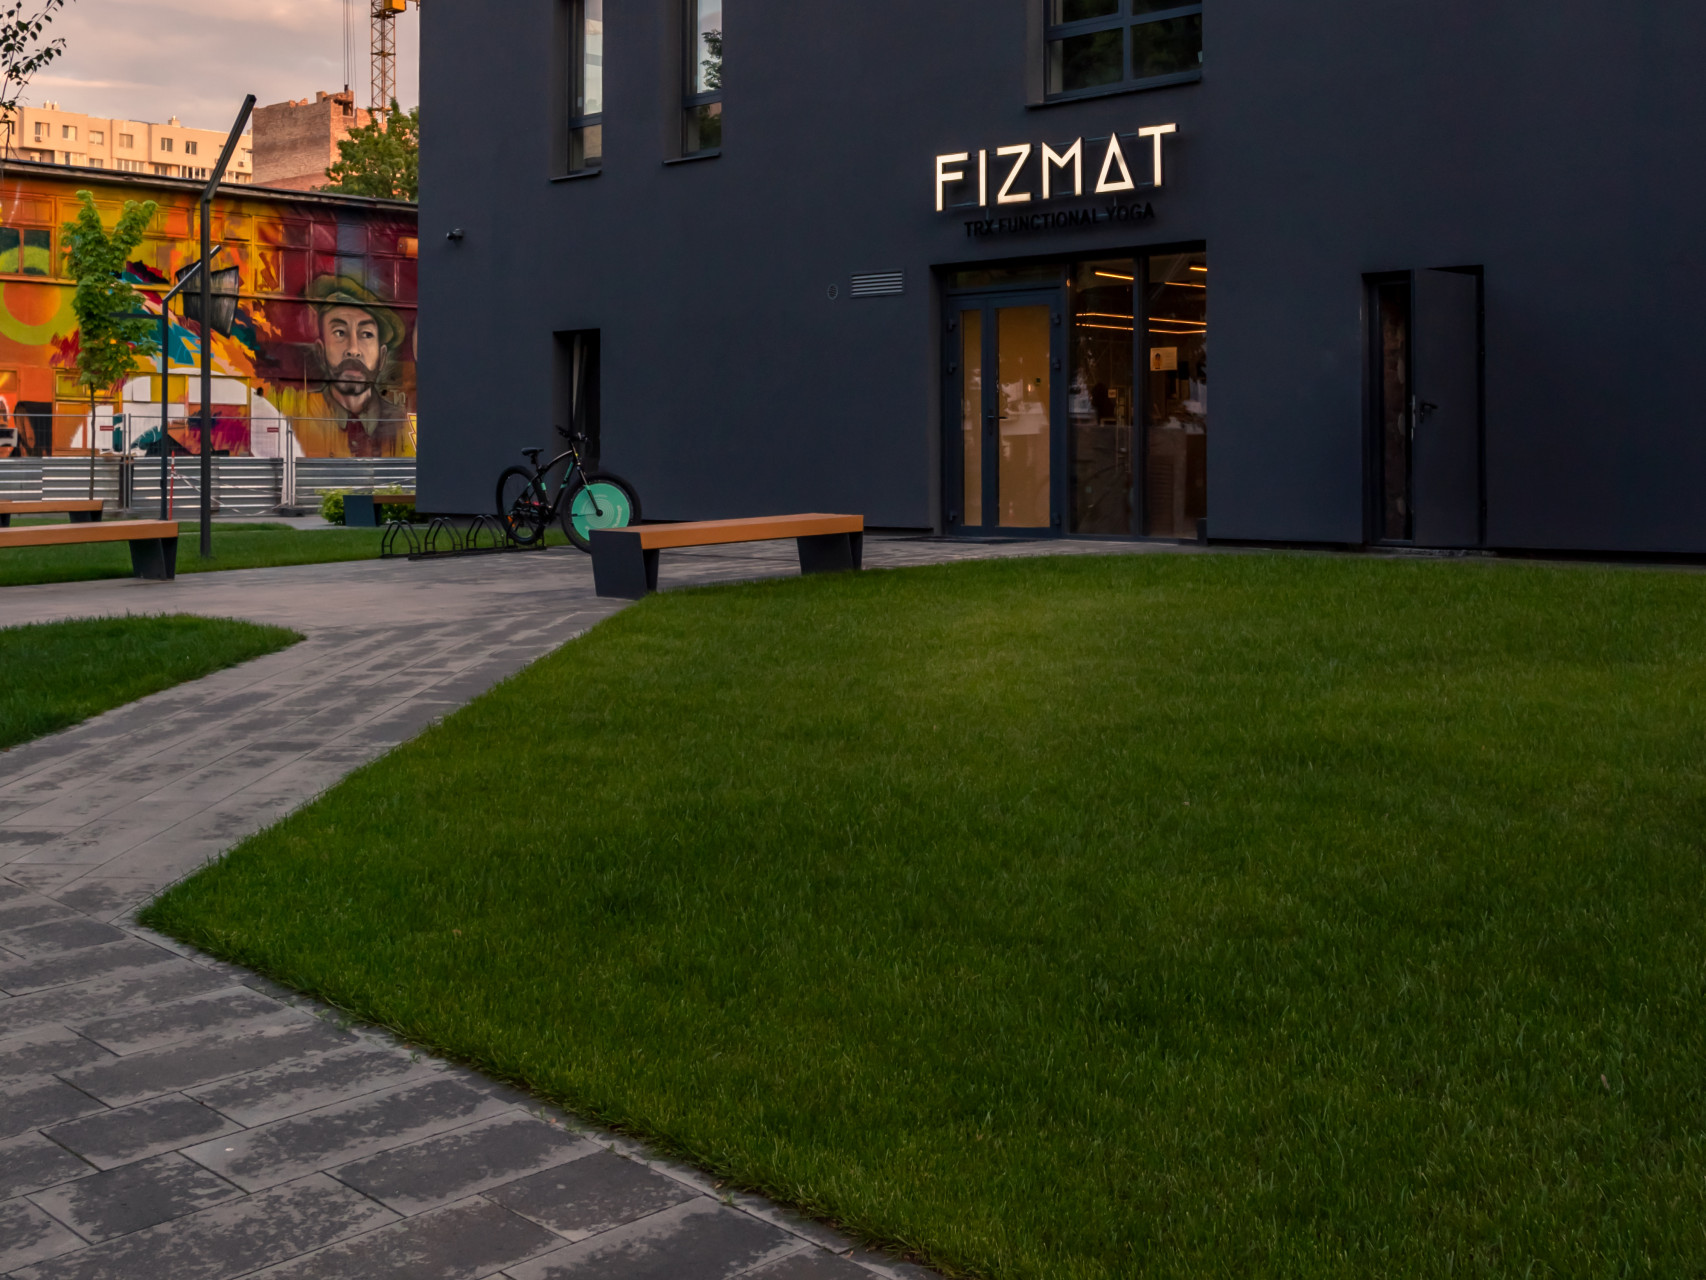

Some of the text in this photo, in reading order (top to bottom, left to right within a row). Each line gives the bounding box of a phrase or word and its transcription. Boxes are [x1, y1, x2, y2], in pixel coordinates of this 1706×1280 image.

[934, 122, 1179, 212] FIZMAT
[964, 201, 1155, 237] TRX FUNCTIONAL YOGA
